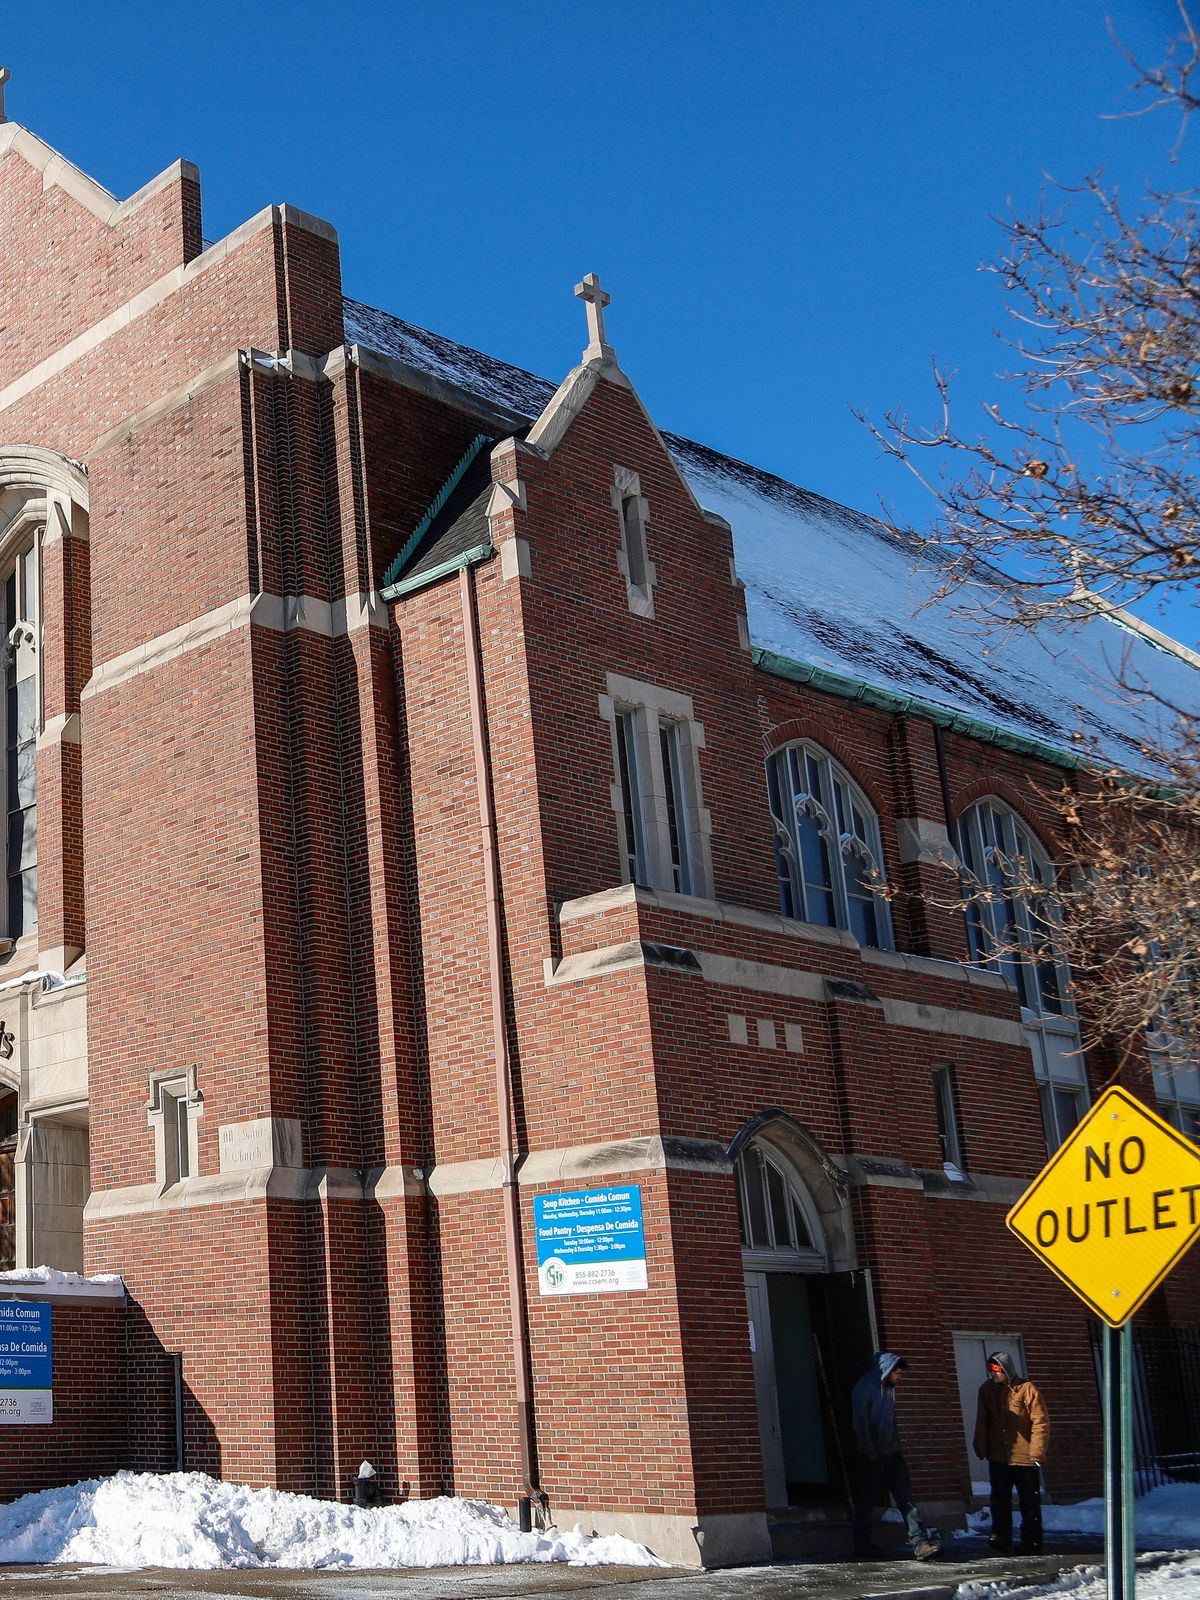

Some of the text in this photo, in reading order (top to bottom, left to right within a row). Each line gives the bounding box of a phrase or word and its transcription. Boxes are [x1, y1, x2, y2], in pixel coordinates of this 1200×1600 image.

[1085, 1136, 1145, 1182] NO
[543, 1192, 630, 1209] Soup Kitchen Comida Comun
[1036, 1184, 1200, 1248] OUTLET
[539, 1220, 638, 1236] Food Pantry Despensa De Comida
[575, 1270, 615, 1278] 855-882-2736
[16, 1308, 40, 1318] Comun
[11, 1342, 19, 1351] De
[21, 1342, 47, 1352] Comida
